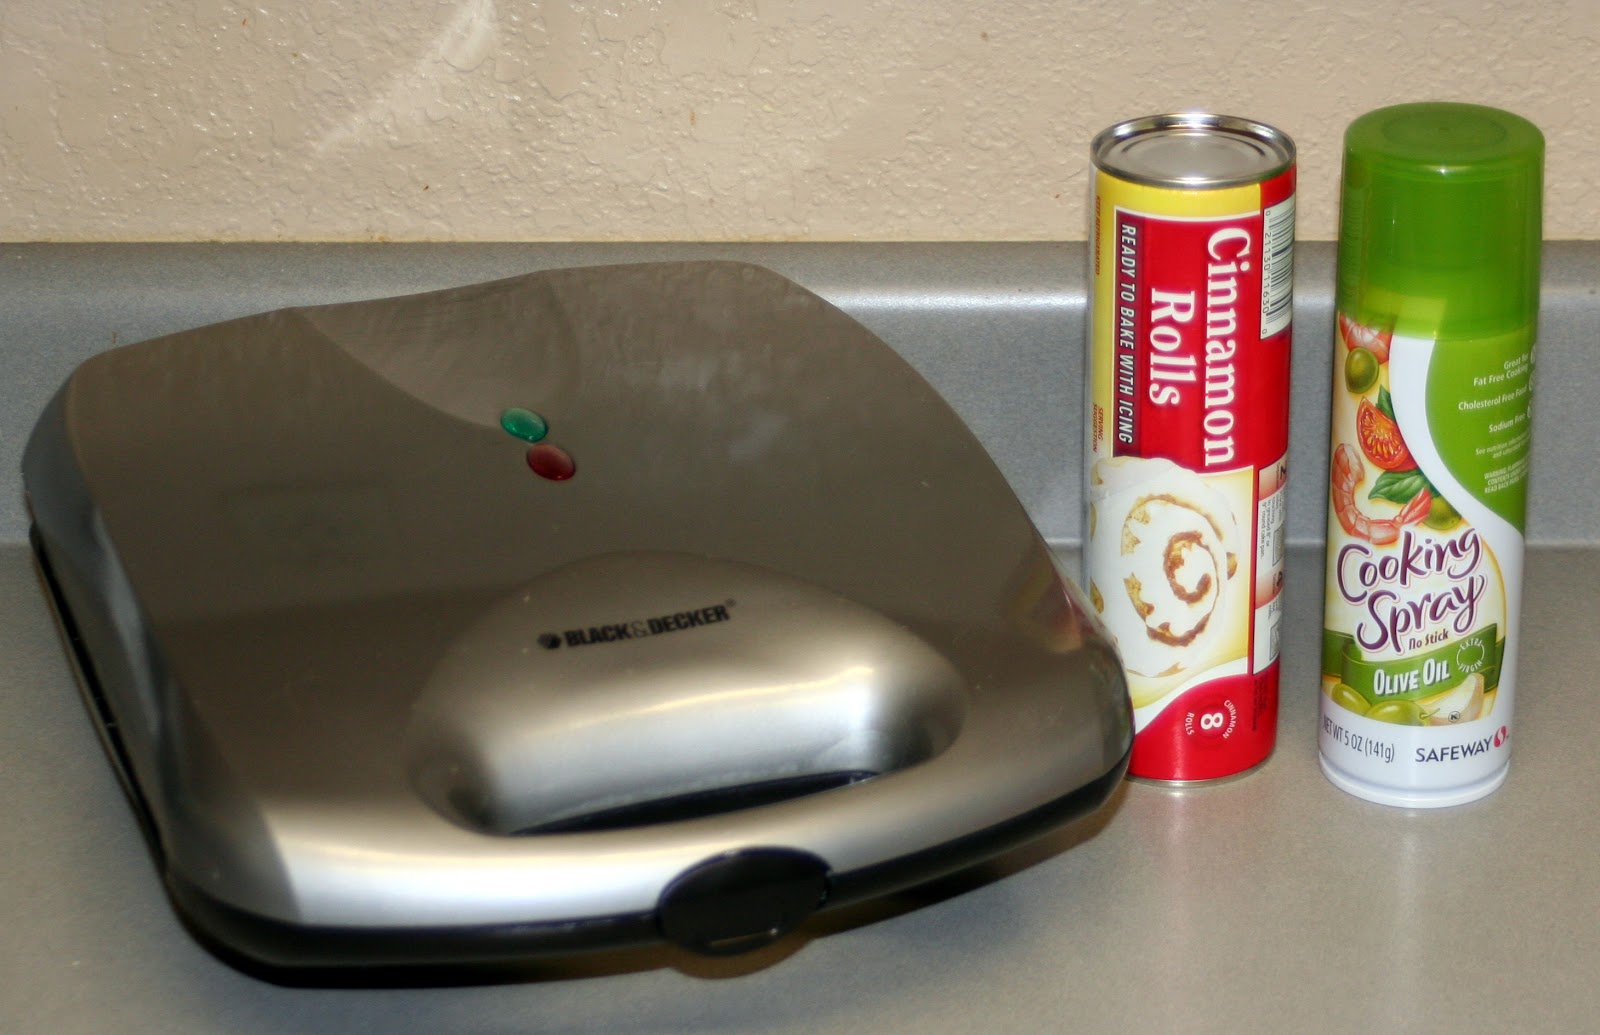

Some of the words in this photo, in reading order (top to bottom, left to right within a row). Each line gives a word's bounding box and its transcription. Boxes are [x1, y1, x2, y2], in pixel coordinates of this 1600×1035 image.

[1120, 223, 1136, 277] READY
[1120, 281, 1135, 302] TO
[1119, 306, 1135, 350] BAKE
[1149, 288, 1197, 406] Rolls
[1203, 227, 1251, 467] Cinnamon
[1504, 357, 1521, 370] Great
[1119, 354, 1134, 394] WITH
[1473, 377, 1487, 386] Fat
[1489, 374, 1505, 383] Free
[1458, 395, 1501, 410] Cholesterol
[1502, 393, 1515, 403] Free
[1118, 401, 1133, 445] ICING
[1488, 419, 1514, 433] Sodium
[1337, 528, 1481, 602] Cooking
[1356, 574, 1485, 653] Spray
[1408, 636, 1422, 650] No
[1424, 628, 1449, 646] Stick
[1460, 638, 1483, 651] EXTRA
[1373, 668, 1420, 695] OLIVE
[1423, 657, 1450, 685] OIL
[1458, 658, 1483, 674] VIRGIN
[1185, 712, 1195, 736] ROLLS
[1200, 711, 1224, 730] 8
[1222, 699, 1237, 740] CINNAMON
[1323, 715, 1332, 738] NET
[1332, 722, 1344, 742] WT
[1344, 730, 1350, 746] 5
[1350, 734, 1363, 752] OZ
[1364, 737, 1395, 763] (141g)
[1415, 735, 1493, 763] SAFEWAY
